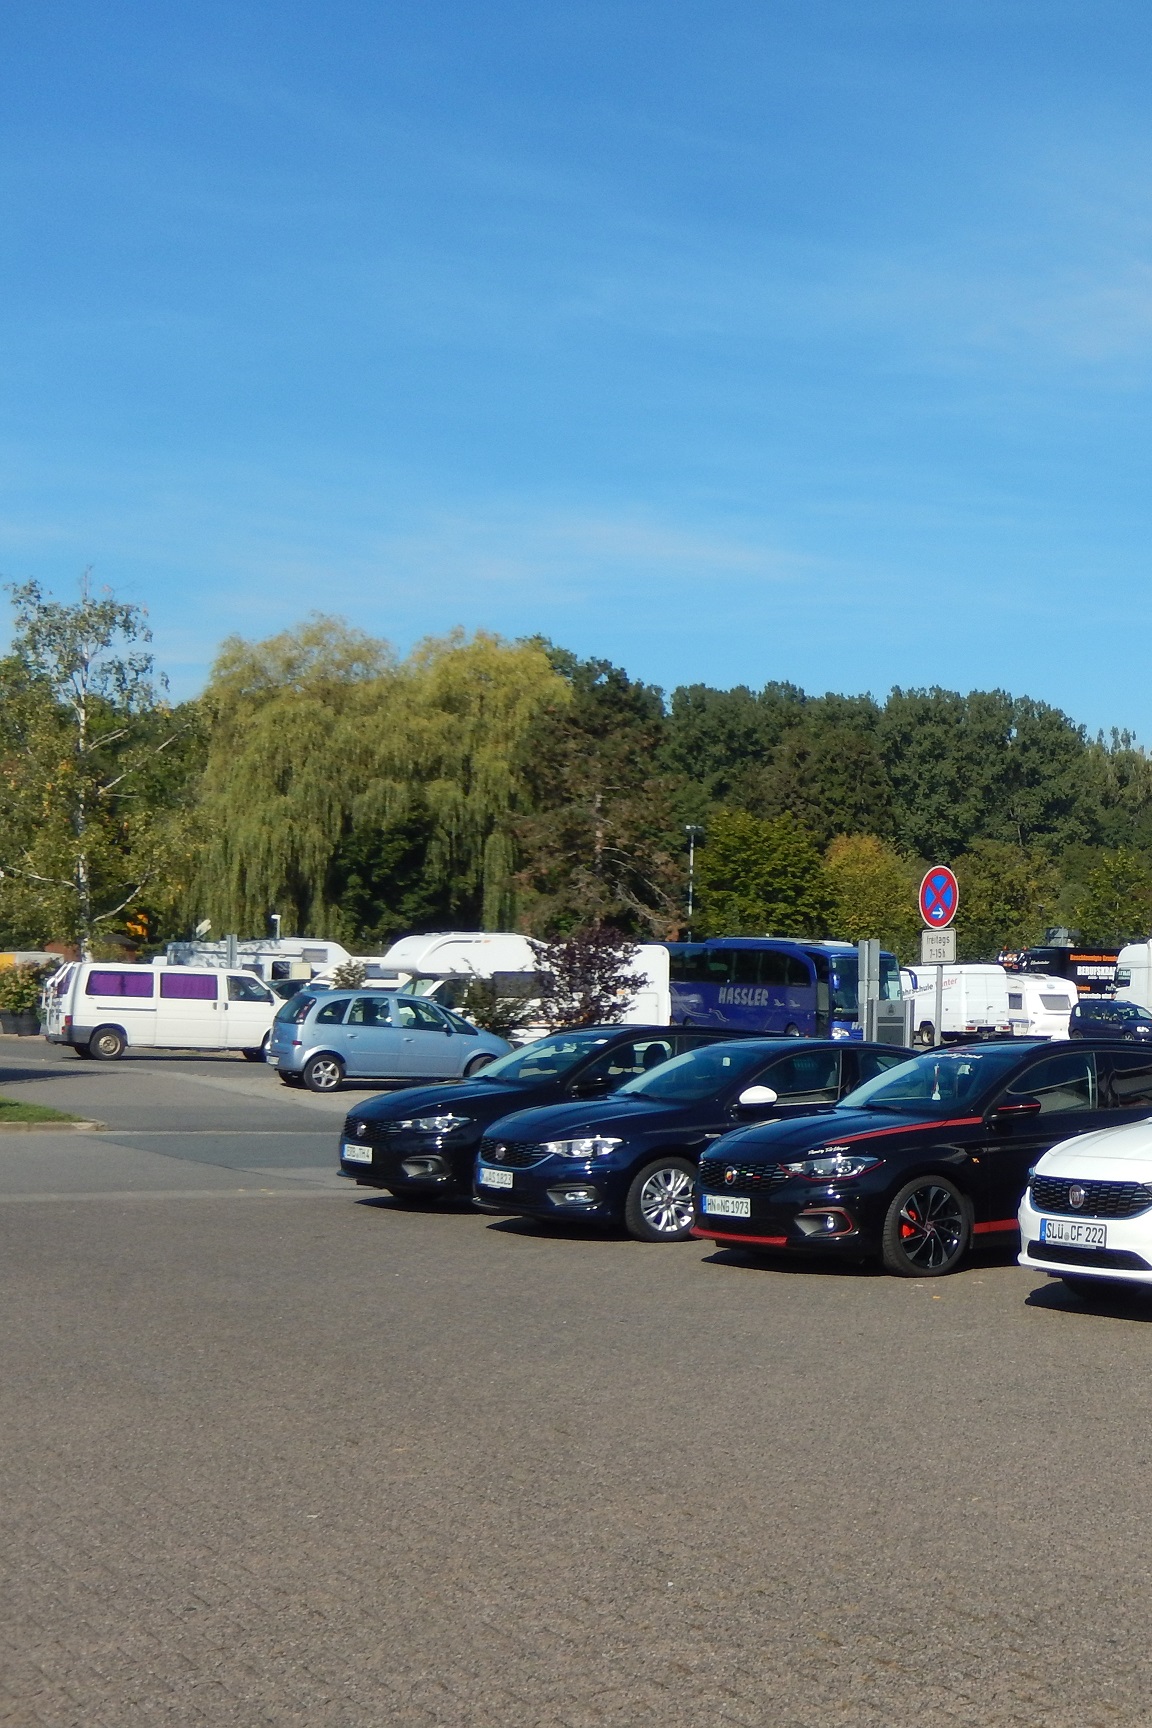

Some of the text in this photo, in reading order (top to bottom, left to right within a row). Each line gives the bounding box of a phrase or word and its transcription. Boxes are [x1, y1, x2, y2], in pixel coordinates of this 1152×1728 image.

[926, 935, 950, 946] freitags
[718, 987, 769, 1006] HASSLER
[707, 1198, 749, 1215] HN NG 1973
[1046, 1222, 1104, 1244] SLÜ CF 222
